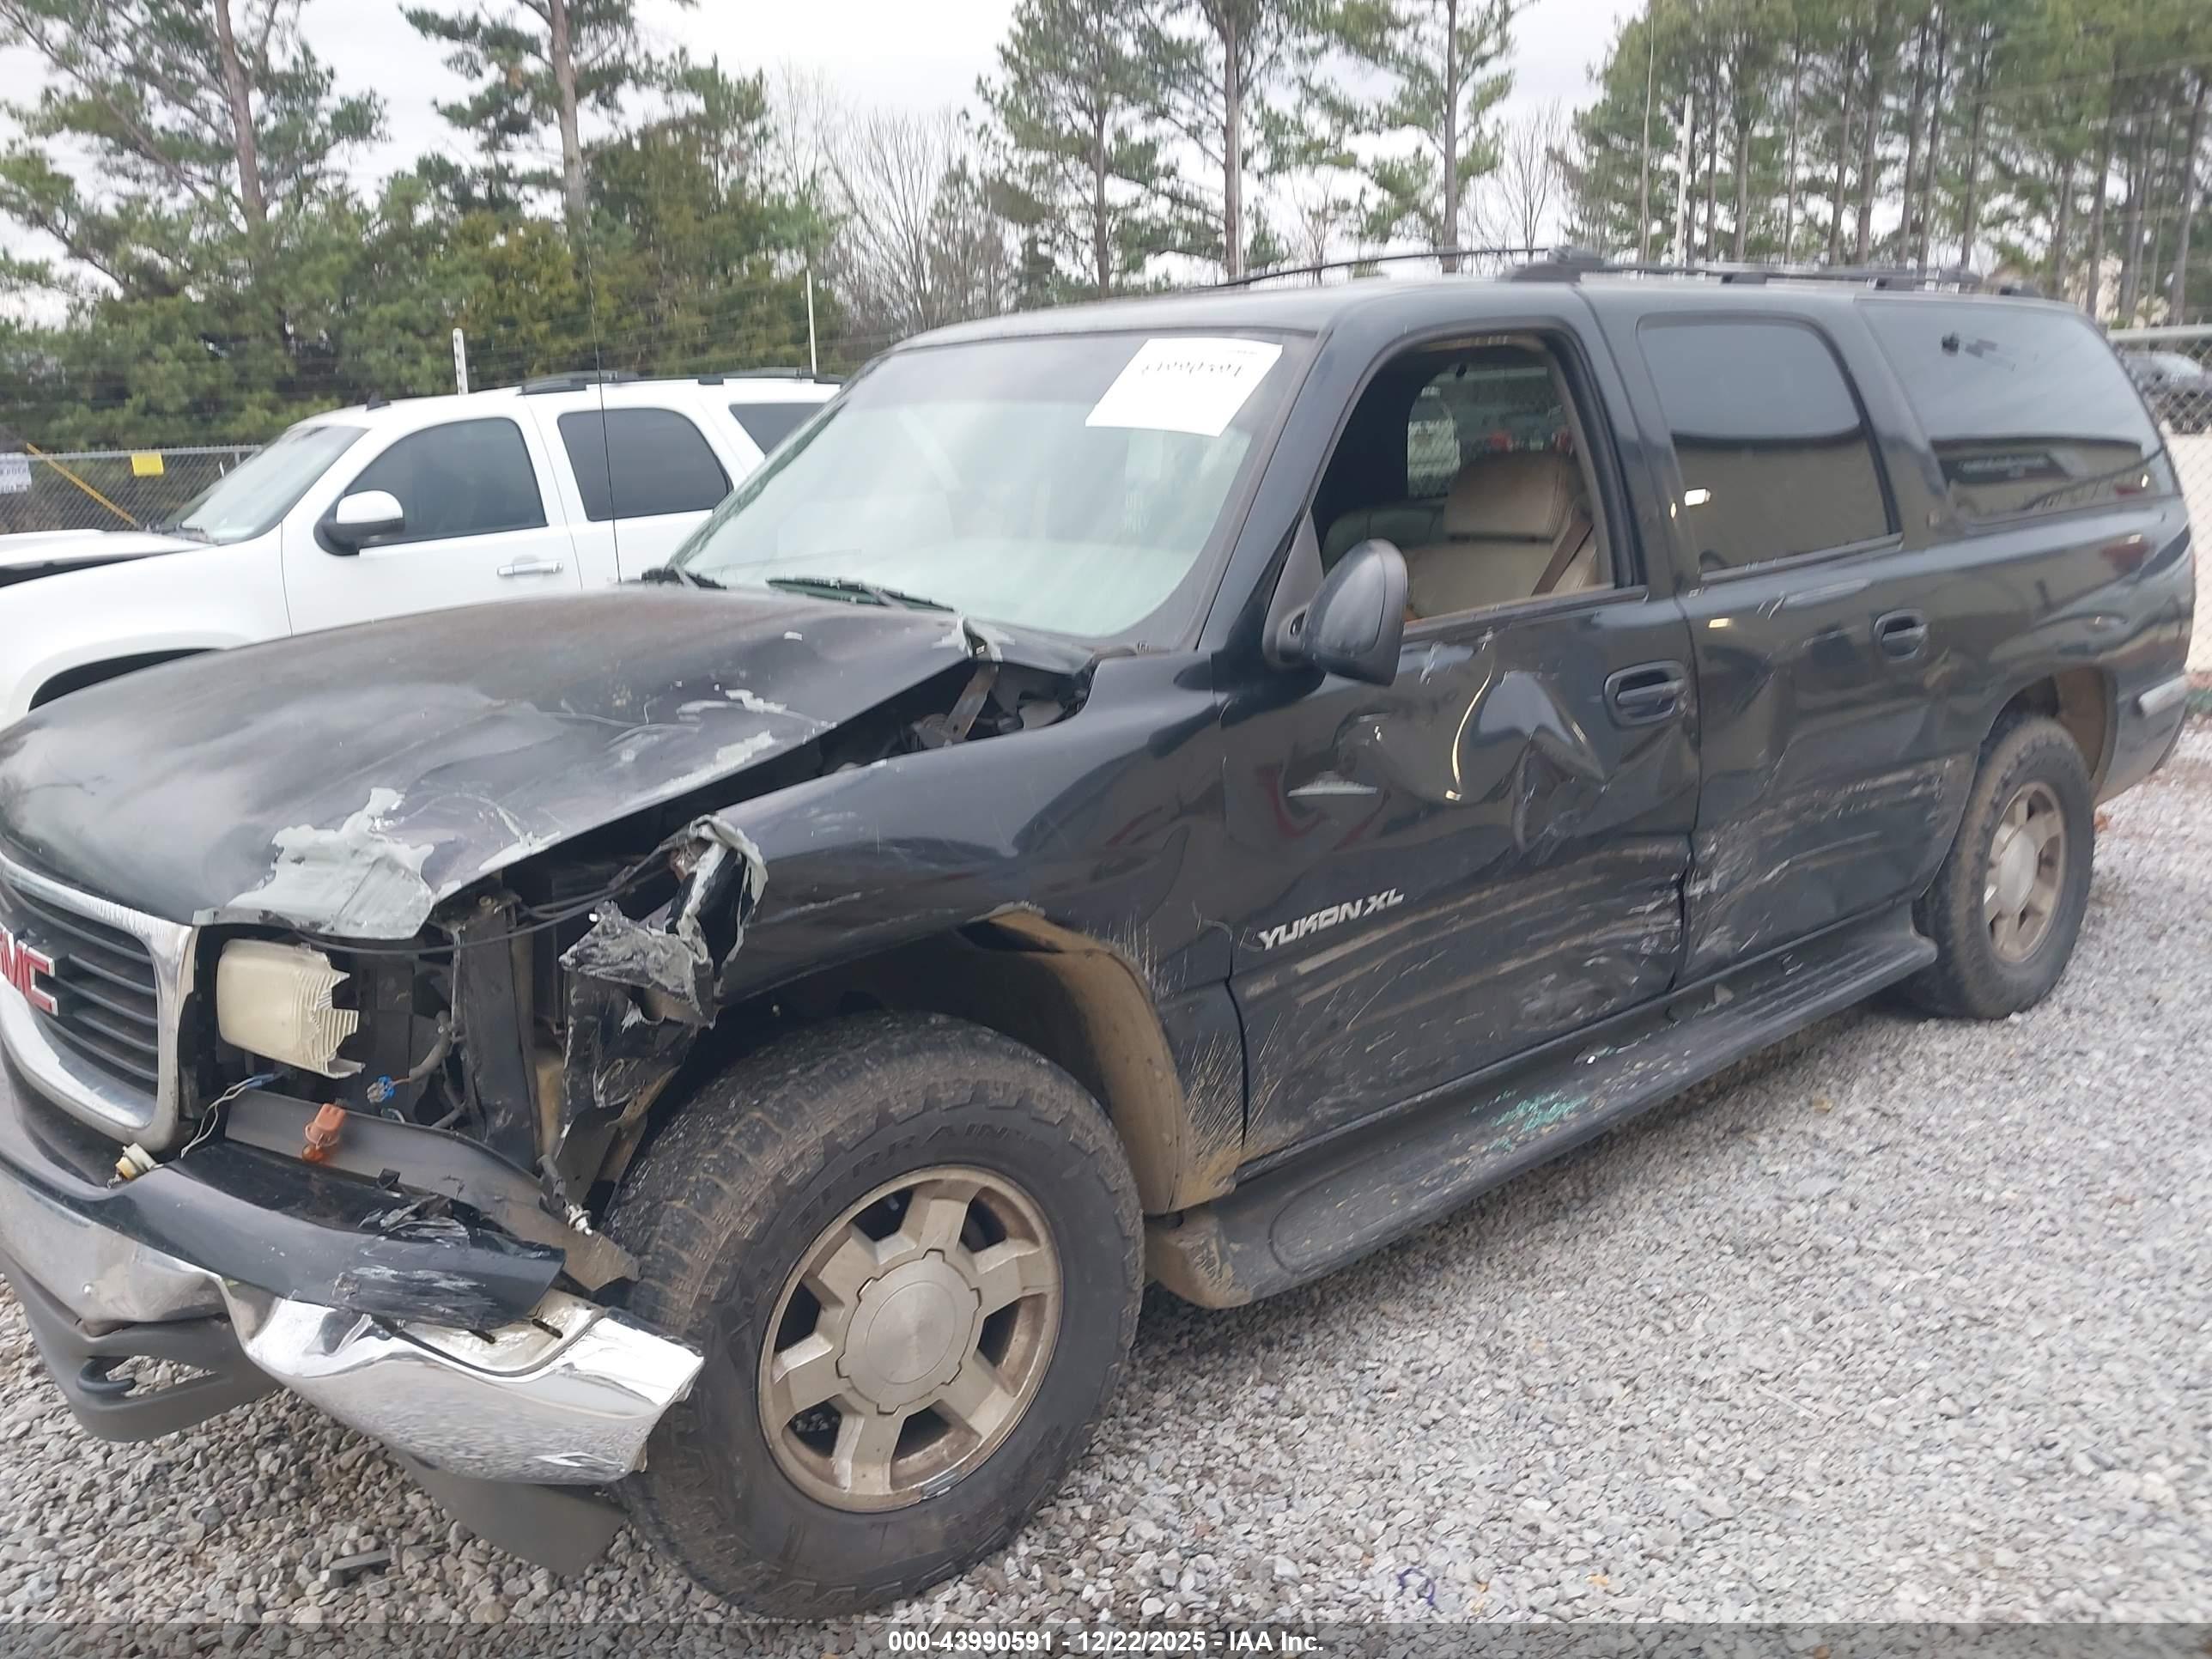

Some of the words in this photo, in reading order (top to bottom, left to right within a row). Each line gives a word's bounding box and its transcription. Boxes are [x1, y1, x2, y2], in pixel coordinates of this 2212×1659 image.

[1257, 898, 1364, 951] YUKON
[1363, 888, 1405, 916] XL
[0, 921, 58, 1016] MC
